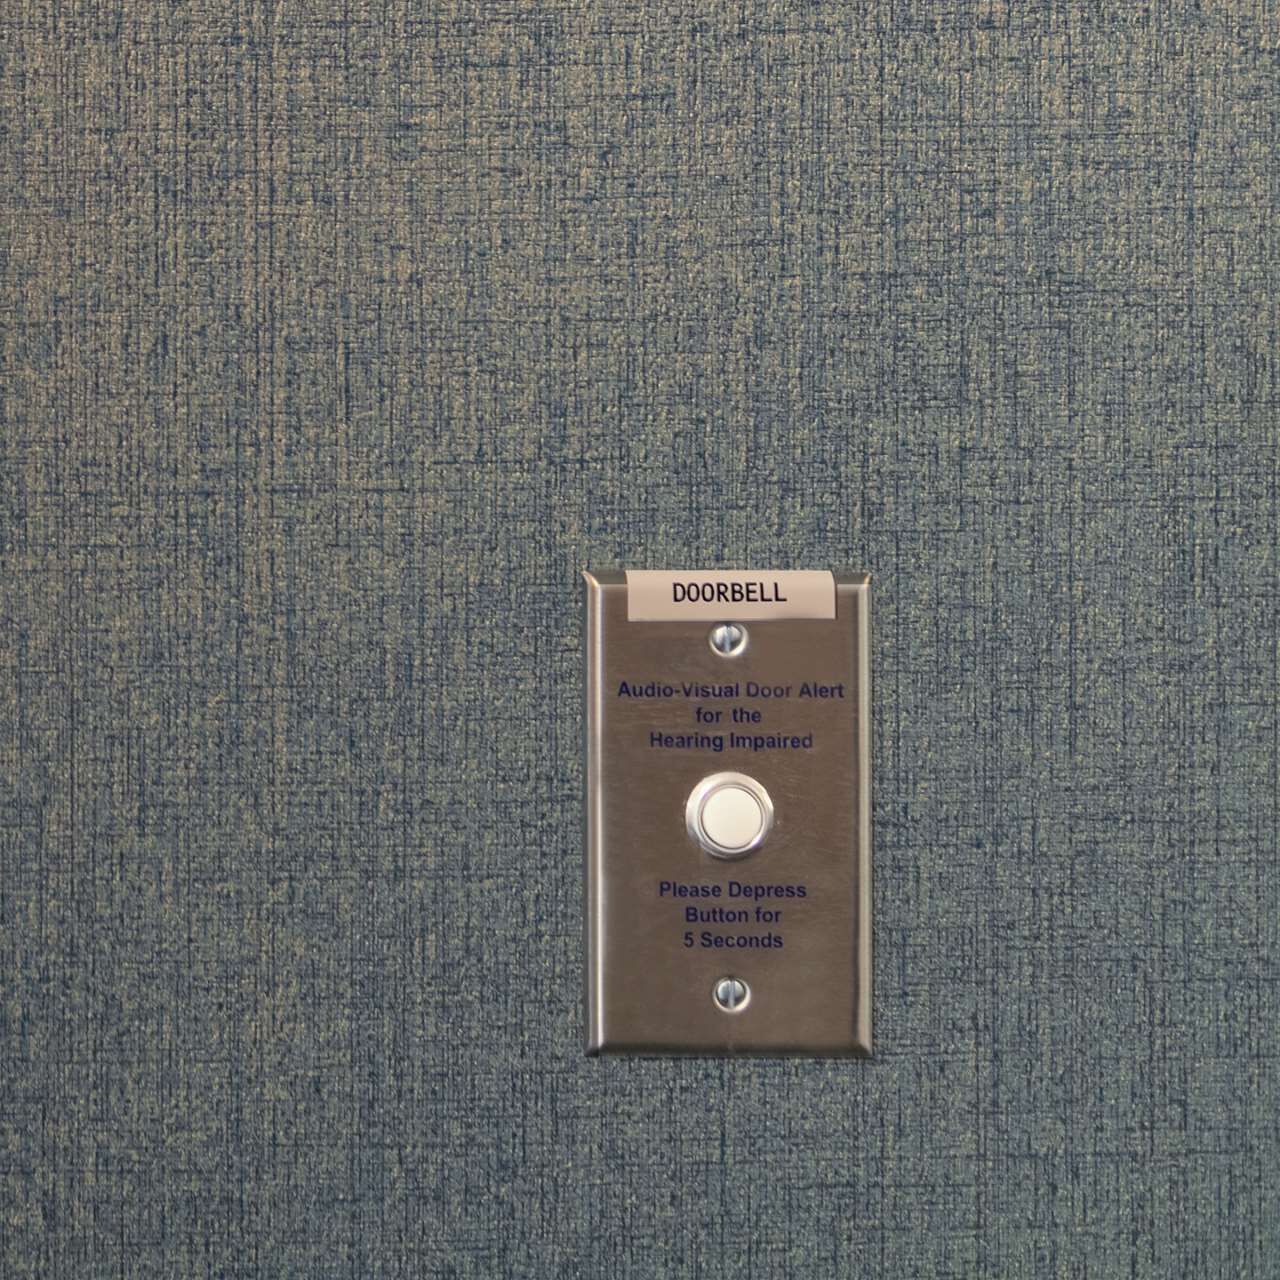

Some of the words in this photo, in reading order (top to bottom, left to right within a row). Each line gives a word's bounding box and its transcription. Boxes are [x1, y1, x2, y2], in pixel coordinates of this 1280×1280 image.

[672, 582, 787, 603] DOORBELL
[617, 681, 740, 699] Audio-Visual
[746, 681, 792, 699] Door
[799, 681, 845, 699] Alert
[695, 706, 723, 723] for
[732, 706, 762, 723] the
[649, 732, 724, 753] Hearing
[730, 732, 813, 753] Impaired
[659, 881, 722, 899] Please
[728, 881, 807, 903] Depress
[685, 907, 749, 924] Button
[754, 907, 782, 924] for
[683, 932, 695, 949] 5
[700, 932, 784, 949] Seconds
